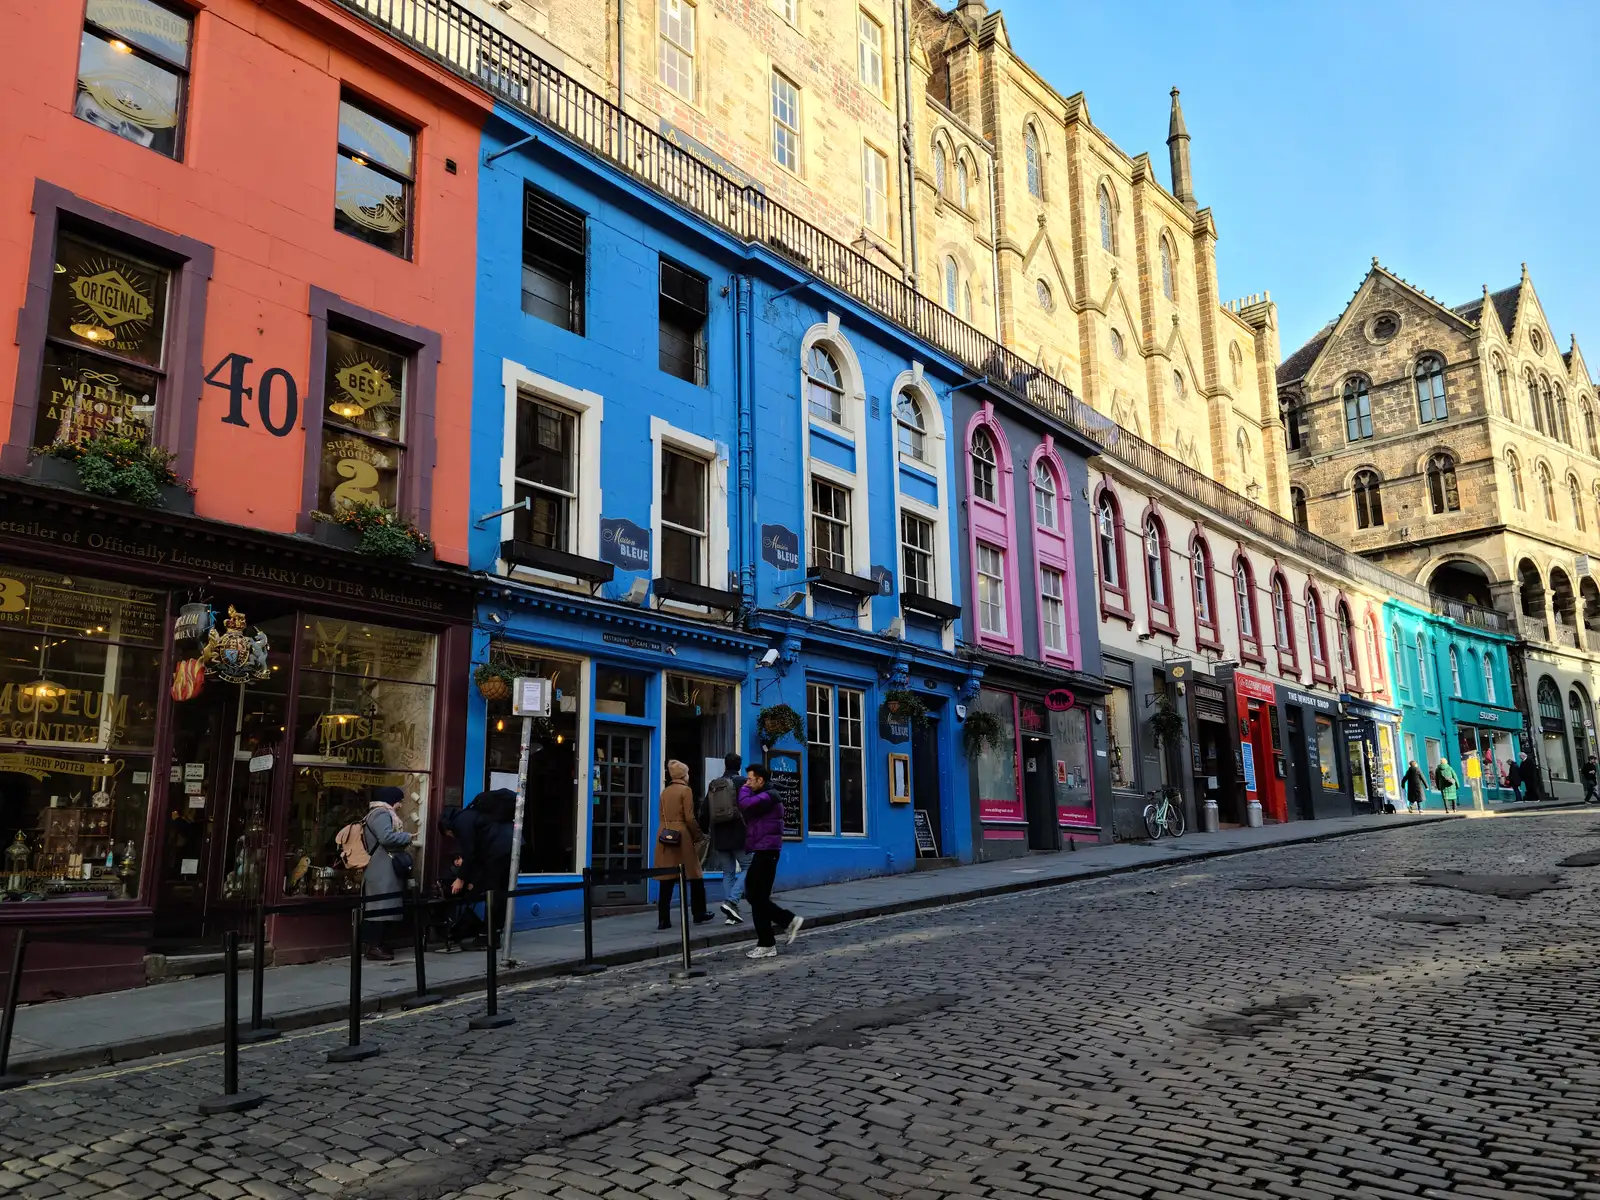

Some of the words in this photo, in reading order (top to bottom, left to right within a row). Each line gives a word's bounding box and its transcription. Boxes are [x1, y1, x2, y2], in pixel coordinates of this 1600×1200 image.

[81, 280, 144, 316] ORIGINAL
[60, 377, 137, 407] WORLD
[204, 352, 298, 437] 40
[348, 373, 385, 397] BEST
[50, 390, 136, 422] FAMOUS
[46, 406, 146, 440] ADMISSION
[334, 458, 380, 505] 2
[620, 543, 649, 562] BLEUE
[776, 549, 799, 565] BLEUE
[0, 519, 57, 541] etailer
[62, 530, 80, 544] of
[88, 533, 167, 565] Officially
[170, 548, 235, 574] Licensed
[241, 563, 300, 585] HARRY
[302, 574, 365, 597] POTTER
[371, 586, 444, 611] Merchandise
[1287, 691, 1298, 702] THE
[1298, 694, 1317, 706] WHISKY
[1317, 699, 1330, 709] SHOP
[1479, 711, 1499, 721] SWISH
[10, 720, 99, 744] CONTEXT
[23, 755, 53, 770] HARRY
[54, 760, 86, 773] POTTER
[337, 746, 391, 765] CONTE
